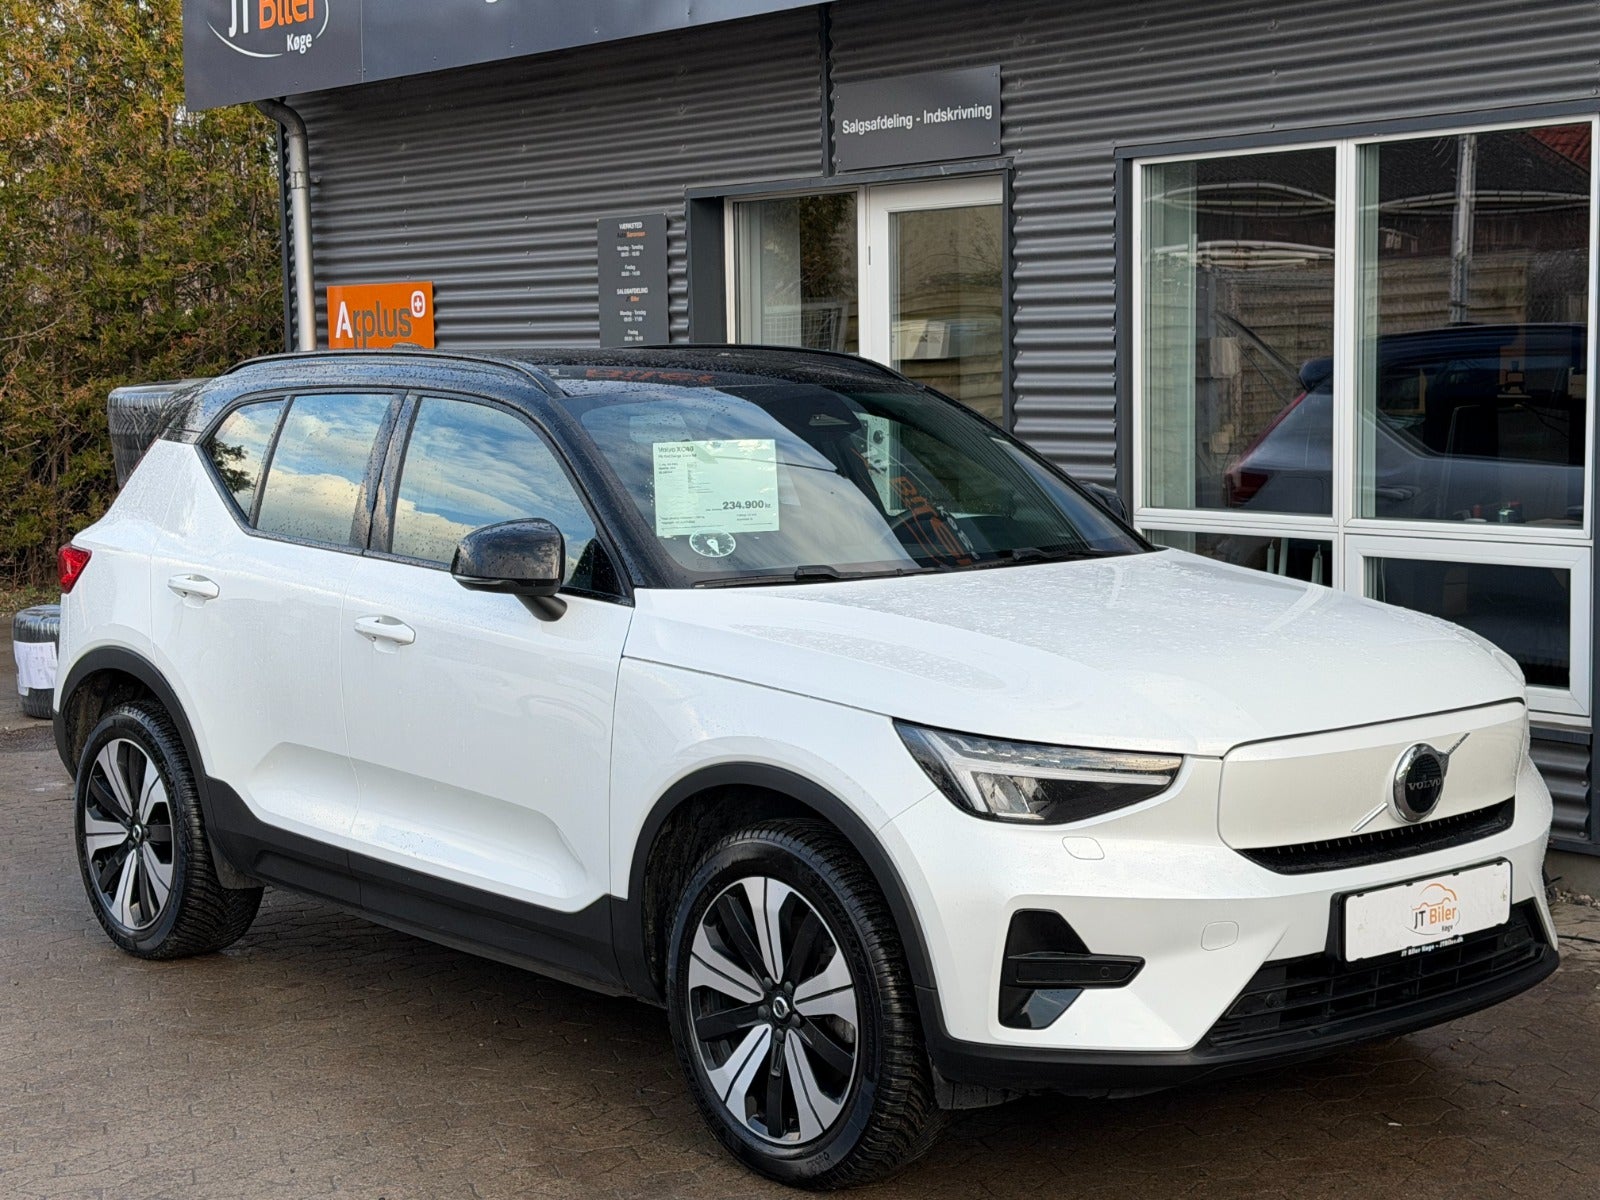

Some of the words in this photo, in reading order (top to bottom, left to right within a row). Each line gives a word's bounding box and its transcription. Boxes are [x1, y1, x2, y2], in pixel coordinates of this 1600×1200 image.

[286, 33, 312, 54] Køge
[842, 113, 913, 136] Salgsafdeling
[923, 103, 993, 126] Indskrivning
[722, 499, 764, 510] 234.900
[1407, 778, 1441, 791] VOLVO
[1413, 910, 1426, 930] JT
[1429, 904, 1457, 925] Biler
